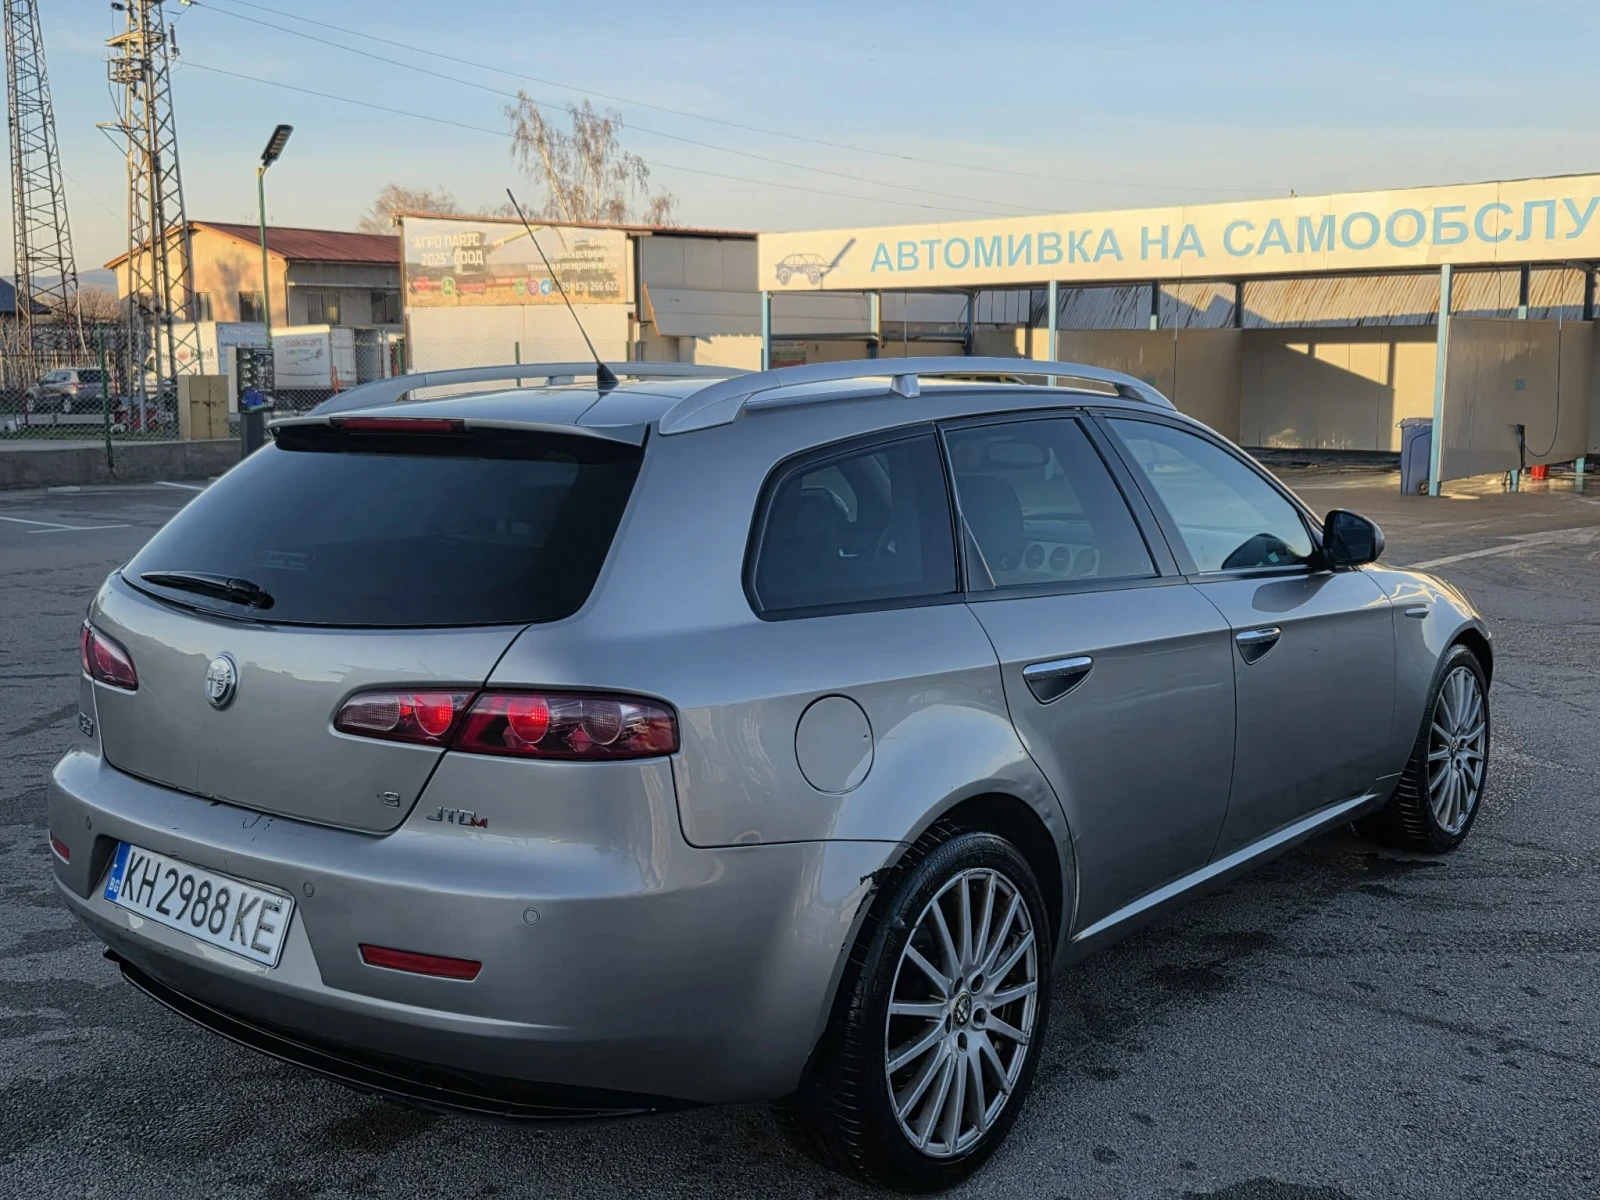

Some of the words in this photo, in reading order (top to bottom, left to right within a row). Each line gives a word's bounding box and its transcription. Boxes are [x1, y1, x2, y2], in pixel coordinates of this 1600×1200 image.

[444, 233, 480, 249] ПАРТС
[870, 228, 1124, 273] АВТОМИВКА
[1141, 223, 1206, 260] НА
[1223, 197, 1600, 256] САМООБСЛУ
[526, 262, 555, 271] техниа
[575, 281, 589, 292] 876
[590, 281, 604, 292] 266
[604, 281, 619, 291] 622
[108, 878, 120, 893] BG
